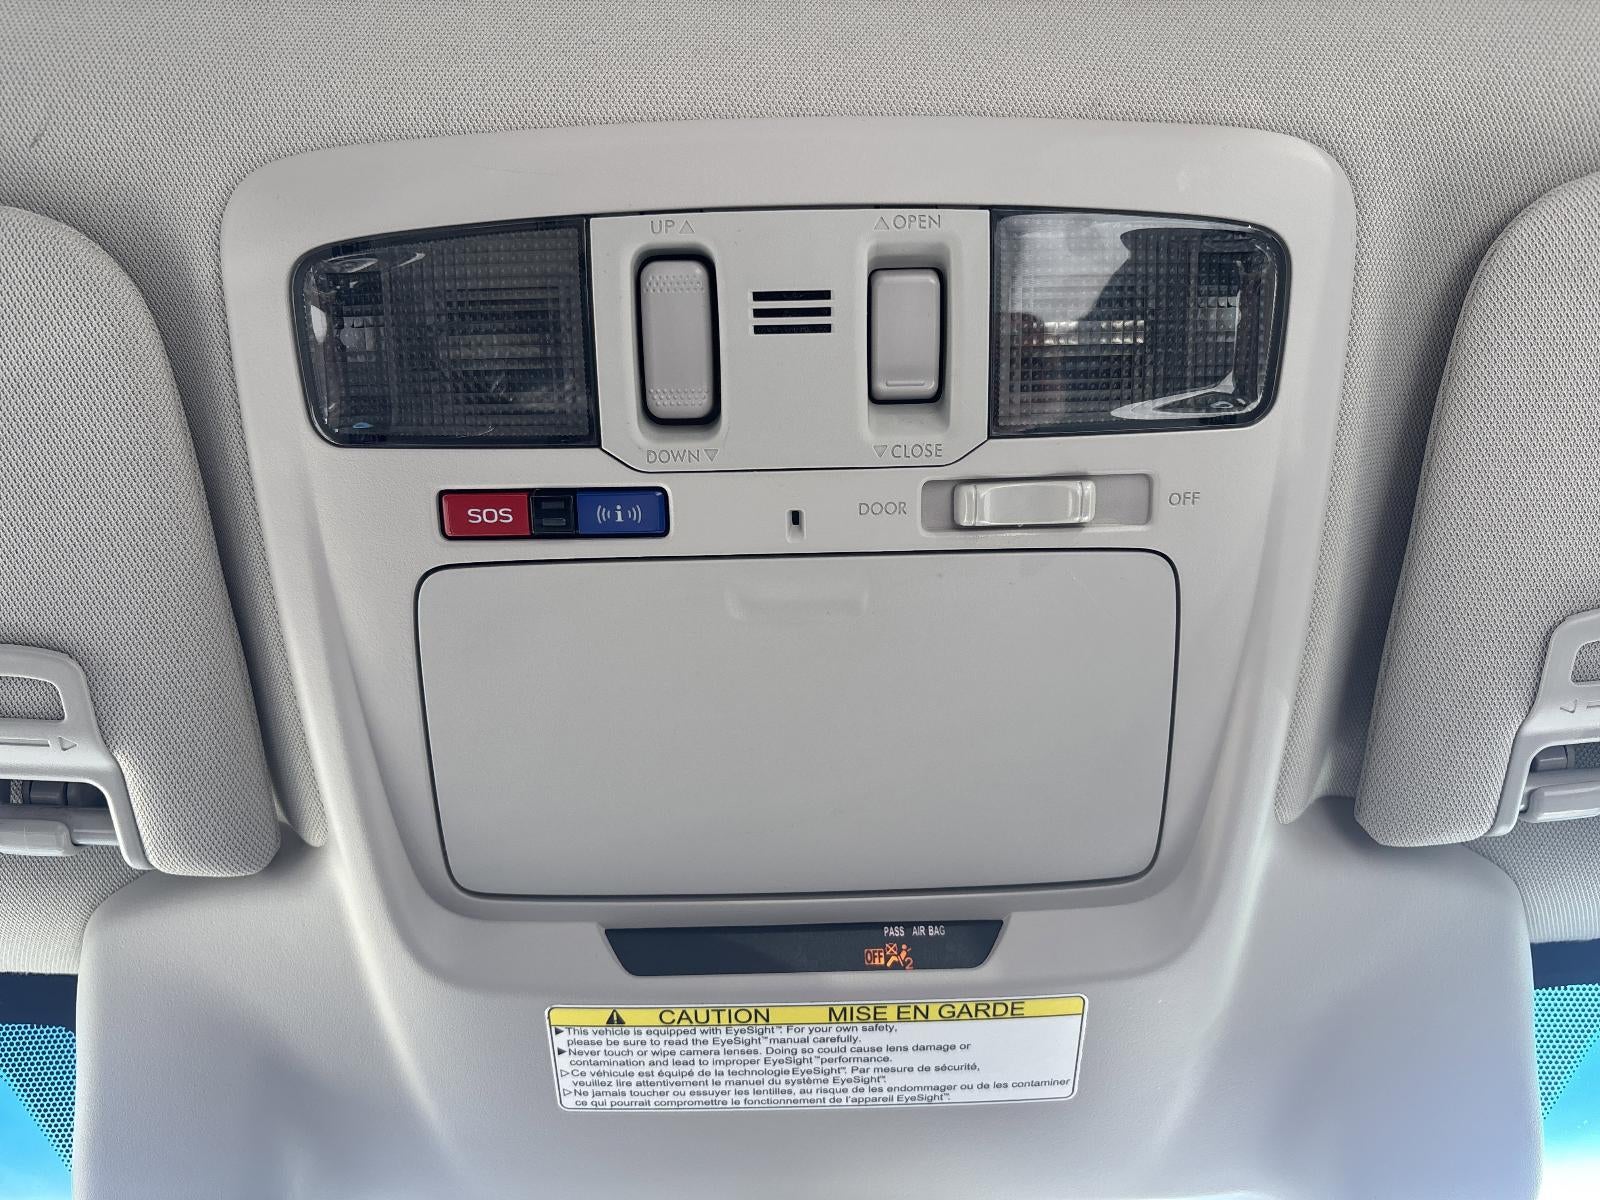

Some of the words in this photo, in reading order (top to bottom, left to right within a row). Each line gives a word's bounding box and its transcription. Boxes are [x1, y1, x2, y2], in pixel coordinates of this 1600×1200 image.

[650, 220, 675, 234] UP
[892, 214, 941, 230] OPEN
[646, 449, 700, 464] DOWN
[891, 444, 943, 458] CLOSE
[1169, 492, 1200, 506] OFF
[468, 508, 514, 524] SOS
[858, 502, 907, 516] DOOR
[884, 926, 905, 937] PASS
[912, 926, 926, 936] AIR
[928, 925, 946, 936] BAG
[865, 950, 884, 964] OFF
[658, 1008, 770, 1024] CAUTION
[828, 1005, 888, 1022] MISE
[896, 1004, 930, 1020] EN
[938, 1001, 1025, 1020] GARDE
[566, 1027, 588, 1036] This
[592, 1028, 630, 1036] vehicle
[646, 1027, 696, 1037] equipped
[700, 1026, 722, 1035] with
[786, 1026, 804, 1034] For
[808, 1026, 832, 1034] your
[862, 1024, 898, 1033] safety,
[567, 1038, 602, 1046] please
[769, 1036, 809, 1044] manual
[813, 1035, 861, 1044] carefully.
[568, 1048, 600, 1056] Never
[604, 1048, 633, 1056] touch
[651, 1048, 676, 1058] wipe
[766, 1046, 797, 1056] Doing
[817, 1045, 846, 1053] could
[912, 1044, 956, 1052] damage
[712, 1058, 760, 1067] improper
[821, 1055, 892, 1065] performance.
[658, 1068, 694, 1078] équipé
[728, 1068, 790, 1077] technologie
[934, 1062, 980, 1072] sécurité,
[592, 1089, 626, 1098] jamais
[753, 1088, 795, 1096] lentilles,
[816, 1086, 848, 1095] risque
[1012, 1078, 1071, 1088] contaminer
[784, 1077, 829, 1086] système
[591, 1099, 607, 1108] qui
[610, 1099, 651, 1108] pourrait
[654, 1098, 728, 1107] compromettre
[744, 1096, 826, 1105] fonctionnement
[846, 1095, 893, 1104] l'appareil
